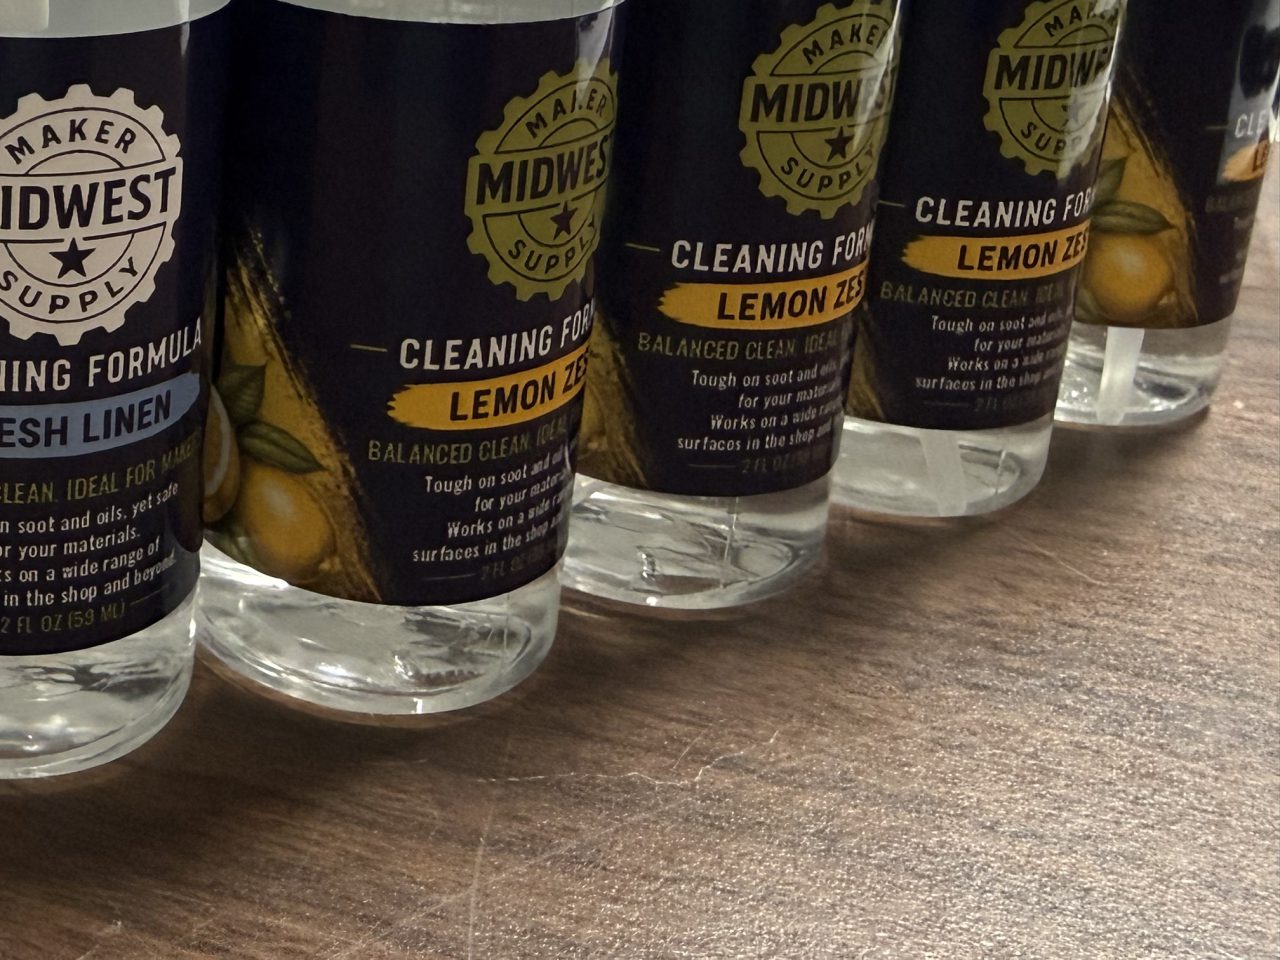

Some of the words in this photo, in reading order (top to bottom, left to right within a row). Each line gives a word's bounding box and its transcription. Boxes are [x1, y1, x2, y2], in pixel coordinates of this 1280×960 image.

[5, 118, 136, 165] MAKER
[476, 134, 608, 205] MIDWES
[916, 196, 1056, 228] CLEANING
[671, 240, 823, 273] CLEANING
[957, 240, 1057, 271] LEMON
[717, 286, 827, 320] LEMON
[880, 281, 976, 307] BALANCED
[931, 315, 973, 335] Tough
[88, 317, 201, 387] FORMULA
[400, 325, 553, 371] CLEANING
[638, 332, 738, 360] BALANCED
[692, 370, 736, 390] Tough
[743, 375, 759, 387] on
[766, 370, 793, 386] soot
[798, 362, 817, 381] and
[449, 372, 555, 422] LEMON
[739, 394, 758, 409] for
[764, 393, 792, 409] your
[83, 390, 171, 442] LINEN
[711, 415, 756, 430] Works
[761, 416, 776, 428] on
[369, 441, 471, 464] BALANCED
[678, 436, 740, 451] surfaces
[747, 436, 760, 450] in
[765, 434, 785, 450] the
[68, 472, 119, 501] IDEAL
[126, 461, 155, 488] FOR
[425, 476, 471, 495] Tough
[478, 476, 495, 487] on
[501, 465, 527, 486] soot
[531, 455, 549, 475] and
[18, 517, 55, 533] soot
[61, 507, 90, 531] and
[132, 494, 153, 518] yet
[157, 481, 178, 505] safe
[475, 497, 494, 513] for
[500, 490, 526, 512] your
[19, 544, 56, 561] your
[64, 525, 141, 555] materials.
[413, 546, 479, 562] surfaces
[485, 541, 496, 555] in
[503, 531, 521, 551] the
[526, 519, 548, 542] shop
[448, 516, 492, 539] Works
[498, 516, 513, 528] on
[19, 569, 38, 581] on
[46, 568, 55, 580] a
[62, 556, 98, 579] wide
[102, 548, 143, 572] range
[147, 535, 161, 558] of
[4, 592, 18, 606] in
[26, 592, 54, 606] the
[62, 582, 97, 603] shop
[104, 572, 129, 594] and
